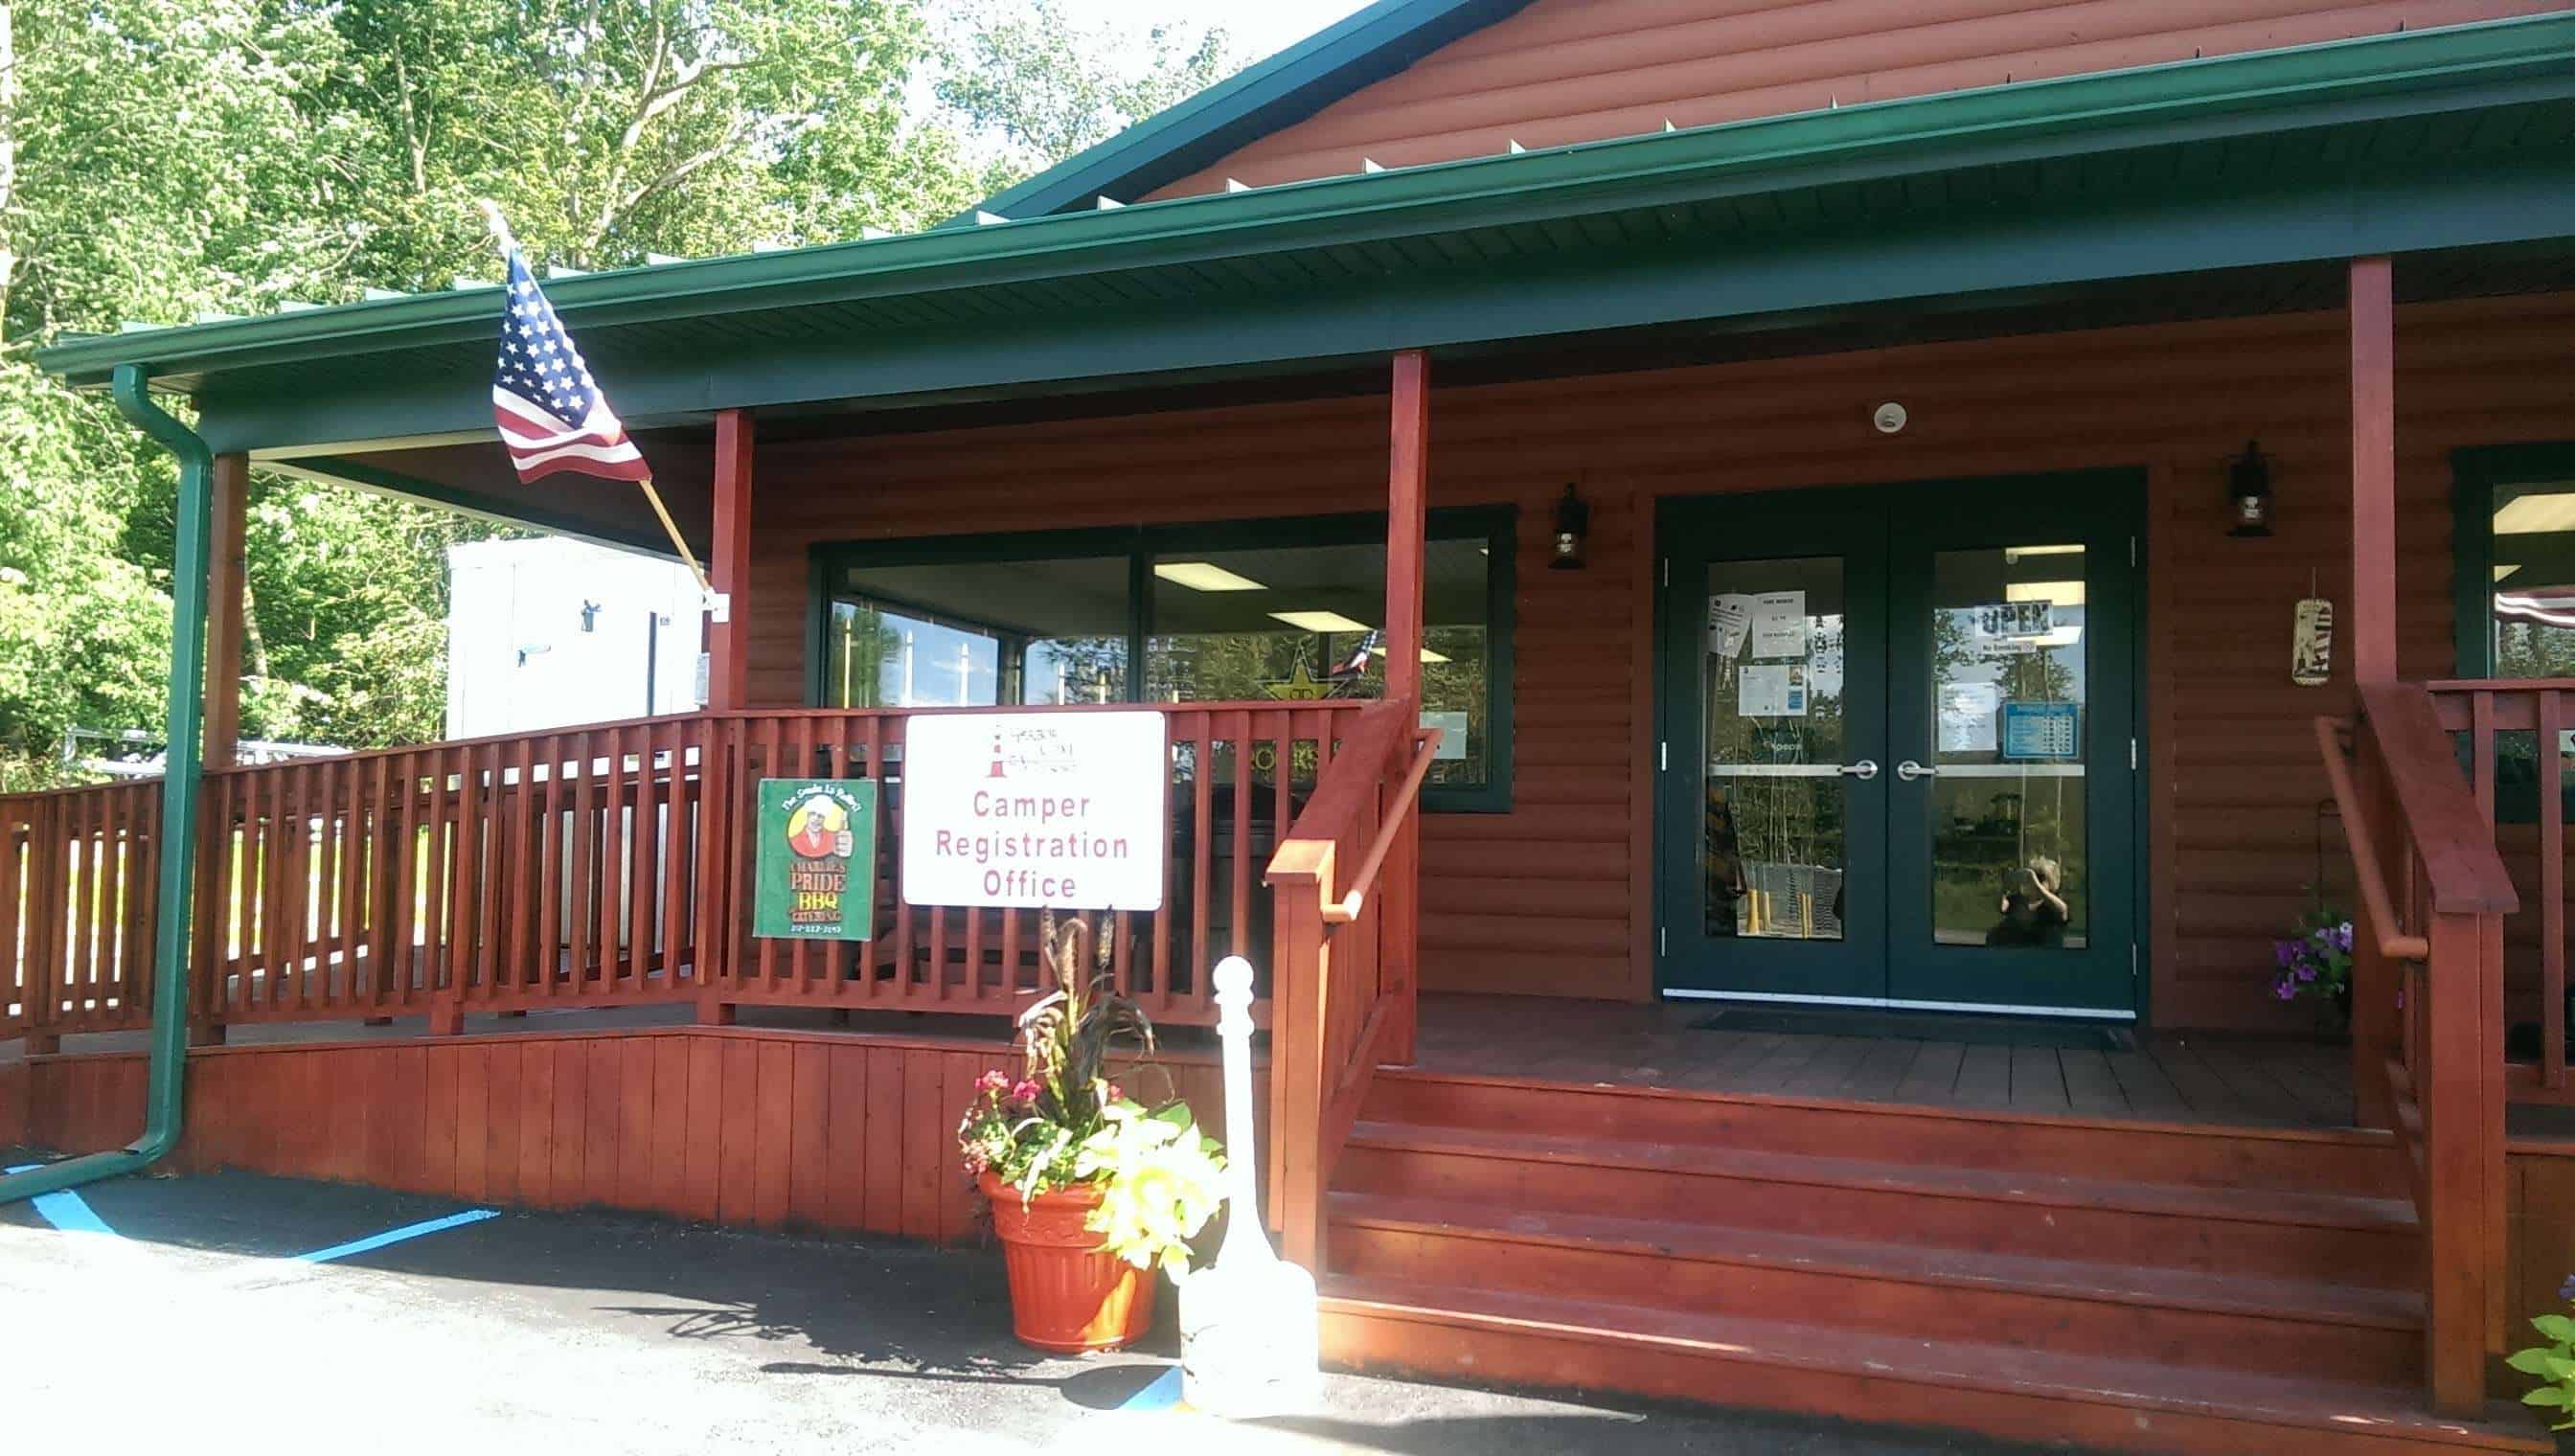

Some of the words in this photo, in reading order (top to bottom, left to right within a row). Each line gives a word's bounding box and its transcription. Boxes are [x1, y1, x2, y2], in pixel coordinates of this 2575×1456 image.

[973, 790, 1090, 825] Camper
[935, 830, 1128, 864] Registration
[790, 873, 847, 893] PRIDE
[984, 869, 1077, 898] Office
[798, 891, 839, 911] BBQ
